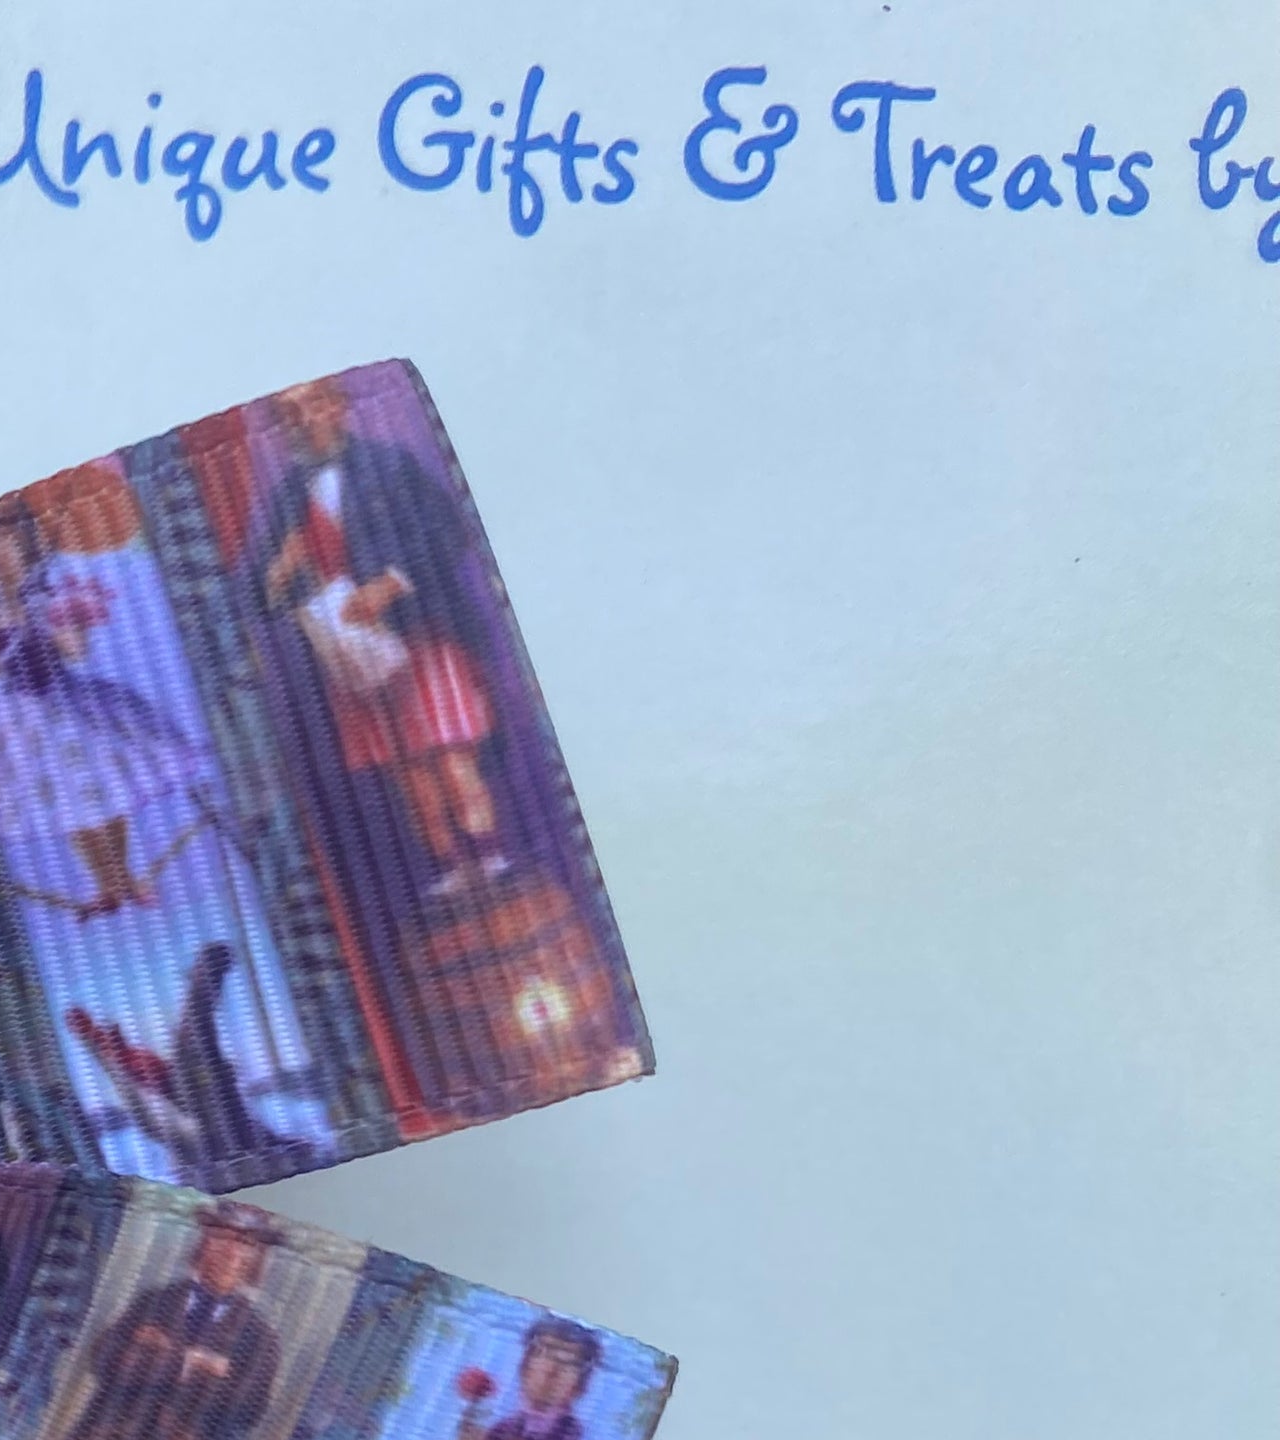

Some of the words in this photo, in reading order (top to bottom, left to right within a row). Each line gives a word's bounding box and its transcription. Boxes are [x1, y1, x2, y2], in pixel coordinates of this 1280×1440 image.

[374, 63, 643, 241] Gifts
[679, 64, 802, 206] &
[827, 79, 1156, 220] Treats
